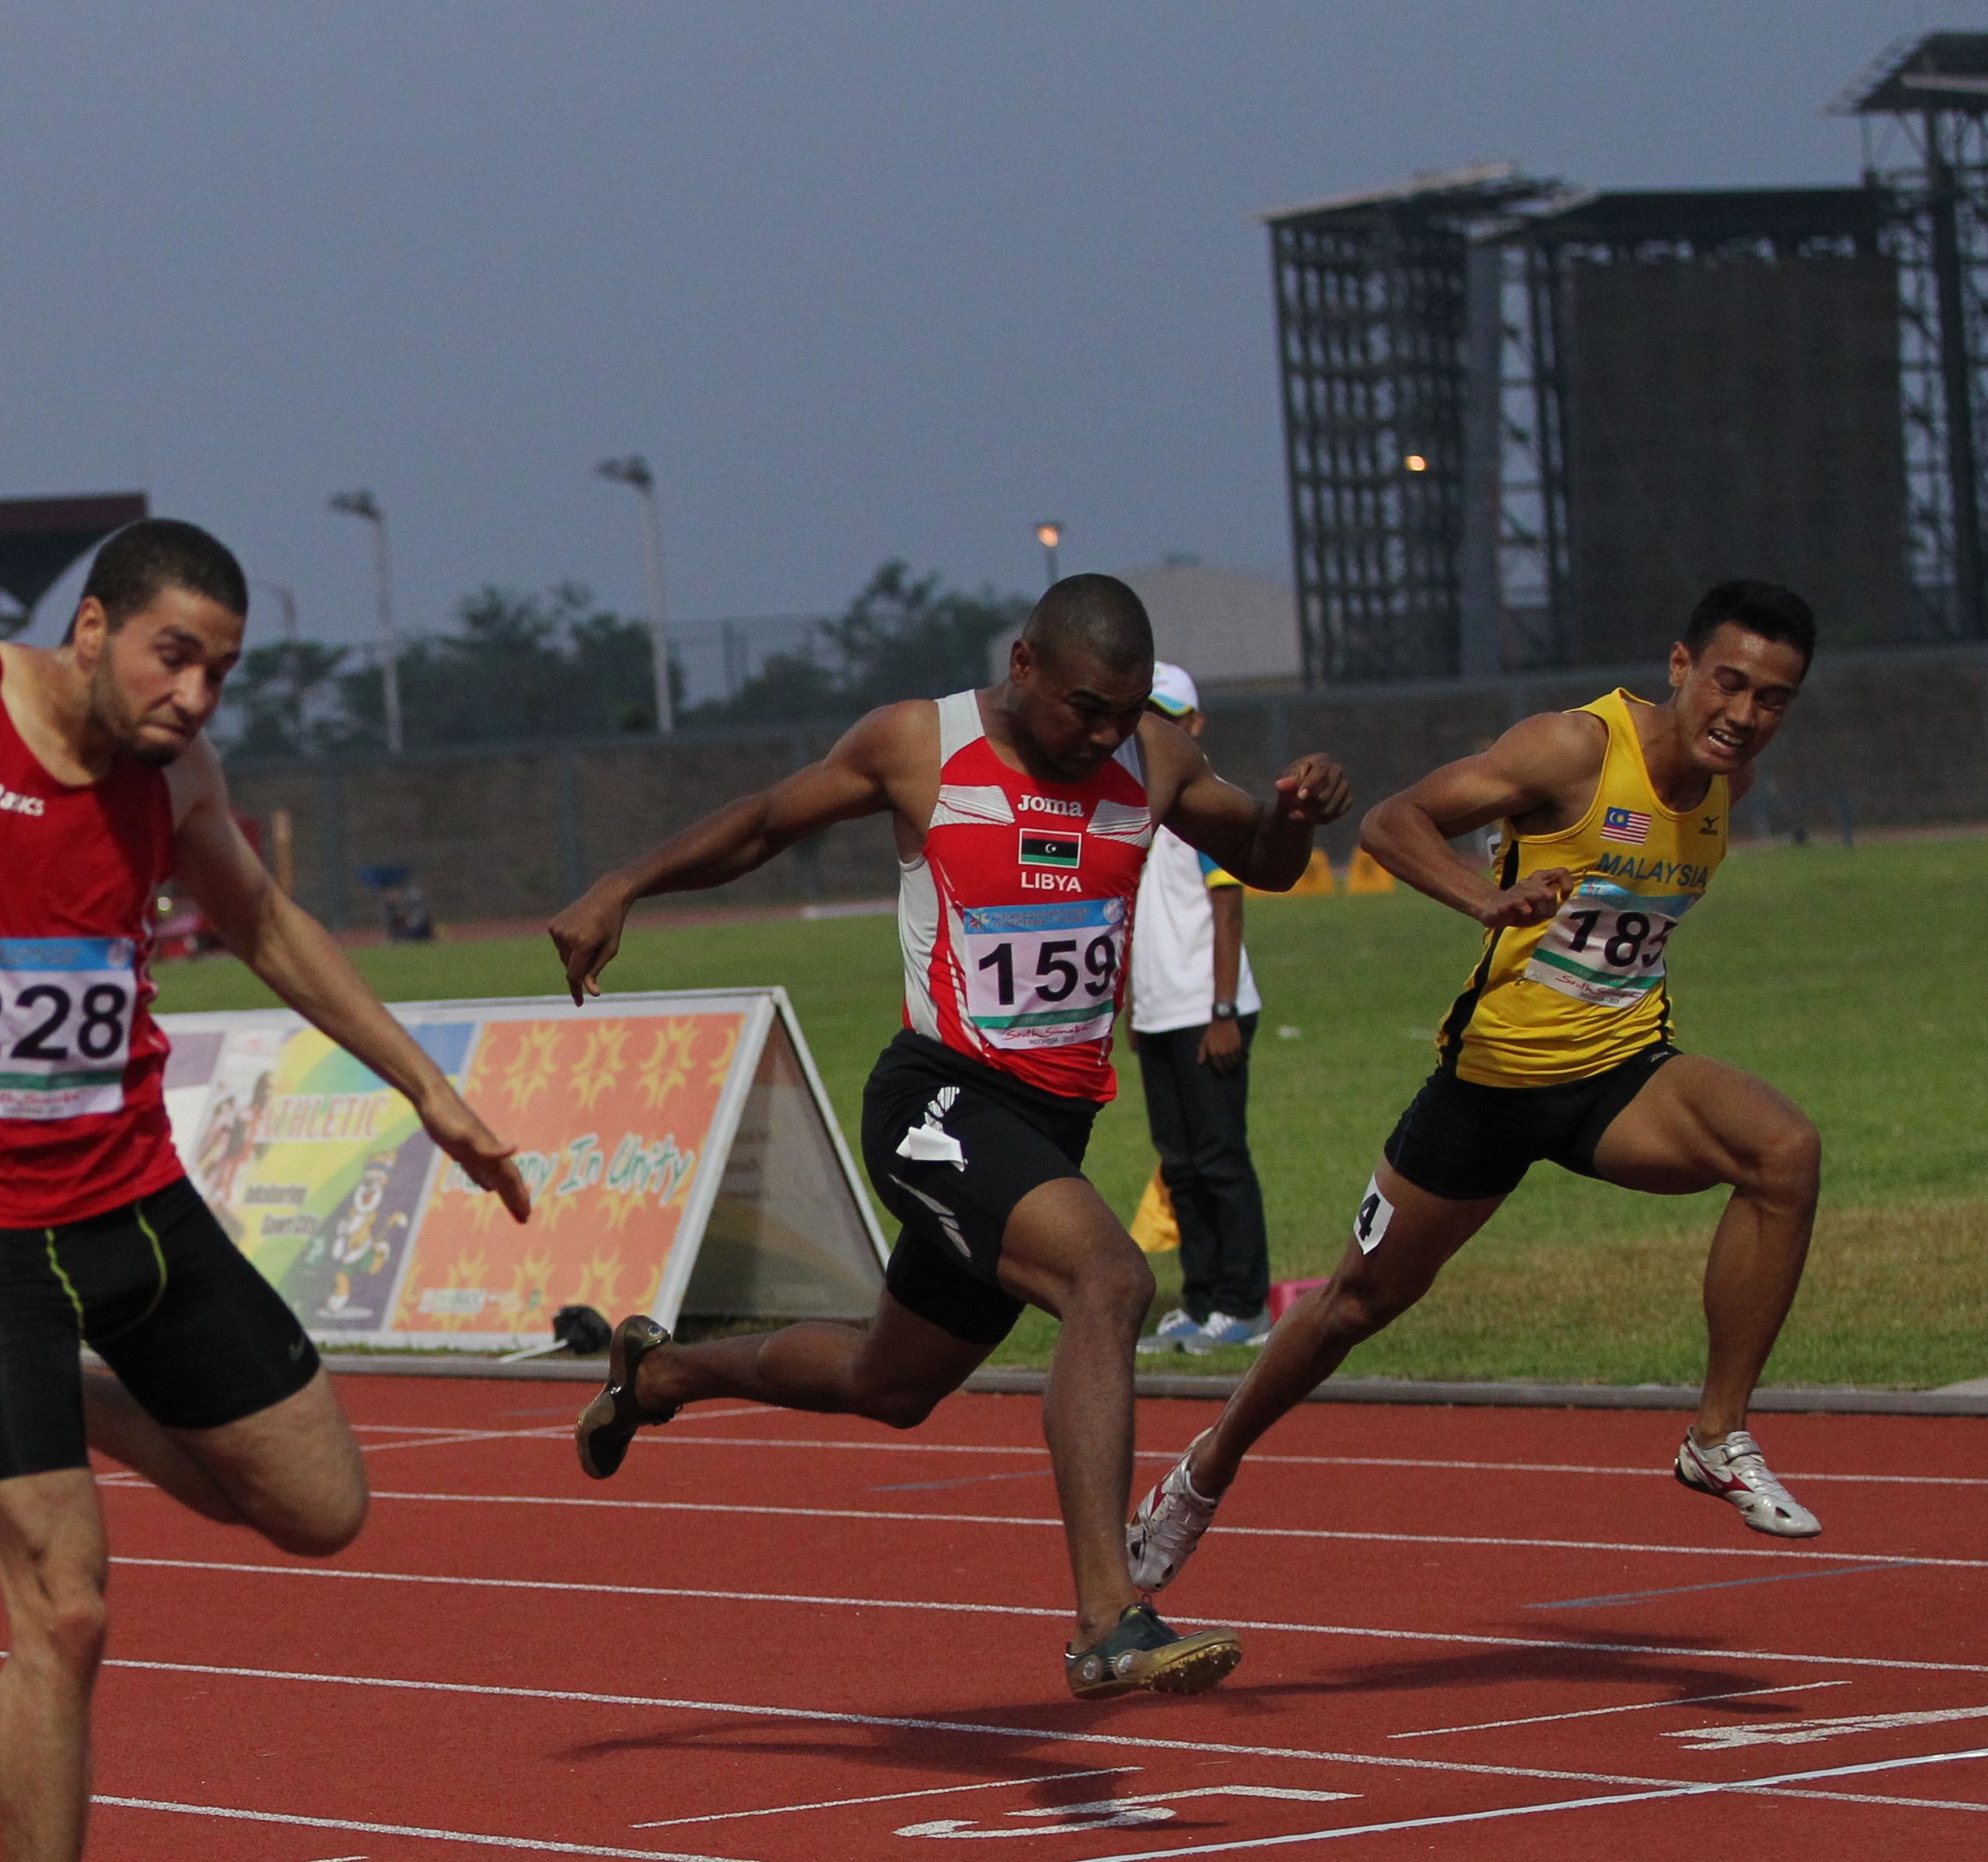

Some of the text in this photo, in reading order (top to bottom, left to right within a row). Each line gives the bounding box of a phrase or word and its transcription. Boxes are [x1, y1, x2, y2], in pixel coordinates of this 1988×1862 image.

[1021, 870, 1082, 892] LIBYA
[1594, 852, 1708, 888] MALAYSIA
[978, 935, 1117, 1006] 159
[0, 984, 126, 1060] 28
[556, 1134, 604, 1197] In
[605, 1132, 695, 1207] Unity
[1359, 1192, 1381, 1242] 4
